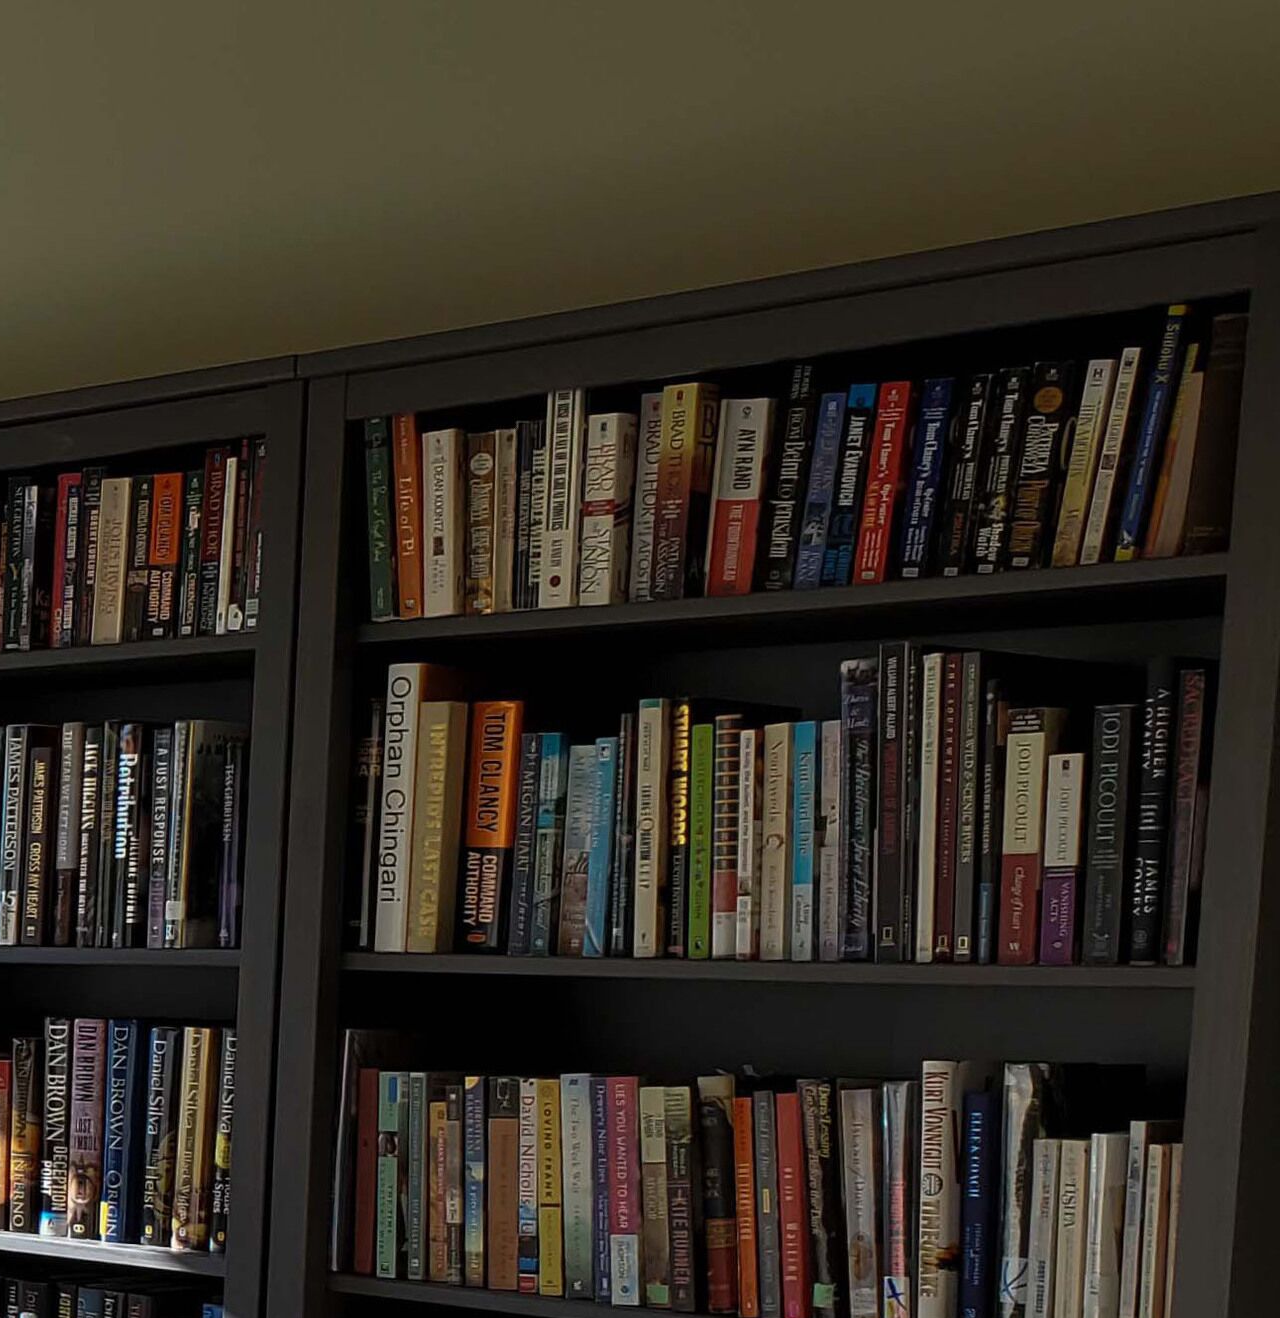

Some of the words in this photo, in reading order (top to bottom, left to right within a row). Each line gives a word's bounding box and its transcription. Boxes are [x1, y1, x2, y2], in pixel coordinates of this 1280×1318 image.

[1160, 323, 1180, 370] Sudoku
[1156, 374, 1168, 383] X
[670, 410, 685, 450] BRAD
[738, 429, 756, 452] AYN
[846, 416, 867, 447] JANET
[1021, 416, 1044, 476] CORNWELL
[208, 471, 221, 508] BRAD
[399, 477, 412, 511] Life
[433, 465, 444, 491] DEAN
[733, 458, 749, 490] RAND
[838, 450, 863, 506] EVANOVICH
[400, 515, 412, 530] of
[433, 494, 444, 532] KOONTZ
[206, 515, 220, 555] THOR
[402, 538, 414, 556] Pi
[598, 529, 611, 573] STATE
[976, 528, 991, 557] Watch
[987, 523, 1003, 561] Shadow
[581, 536, 596, 593] UNION
[147, 570, 161, 623] AUTHORITY
[160, 571, 172, 620] COMMAND
[385, 677, 411, 778] Orphan
[483, 713, 506, 752] TOM
[671, 704, 688, 771] STUART
[1101, 712, 1120, 755] JODI
[1153, 706, 1169, 778] HIGHER
[8, 737, 22, 782] JAMES
[157, 748, 167, 756] A
[964, 739, 975, 767] WILD
[1016, 744, 1031, 776] JODI
[156, 760, 168, 791] JUST
[425, 722, 448, 829] INTREPID'S
[476, 760, 502, 833] CLANCY
[768, 741, 783, 822] Nearlyweds
[520, 770, 538, 826] MEGAN
[670, 776, 687, 845] WOODS
[961, 783, 972, 822] SCENIC
[1014, 781, 1029, 843] PICOULT
[1096, 762, 1118, 842] PICOULT
[4, 786, 20, 870] PATTERSON
[153, 797, 166, 864] RESPONSE
[379, 790, 406, 903] Chingari
[961, 826, 971, 863] RIVERS
[29, 842, 42, 871] CROSS
[422, 837, 443, 883] LAST
[517, 833, 534, 873] HART
[28, 873, 40, 888] MY
[463, 851, 480, 927] AUTHORITY
[478, 855, 497, 923] COMMAND
[26, 890, 39, 919] HEART
[418, 889, 438, 937] CASE
[1059, 882, 1069, 937] VANISHING
[47, 1024, 68, 1067] DAN
[78, 1026, 97, 1050] DAN
[113, 1026, 128, 1070] DAN
[76, 1056, 95, 1102] BROWN
[150, 1039, 167, 1091] Daniel
[46, 1074, 67, 1141] BROWN
[615, 1084, 626, 1106] LIES
[819, 1086, 831, 1117] Doris
[923, 1071, 949, 1103] KURT
[108, 1078, 125, 1150] BROWN
[147, 1095, 164, 1135] Silva
[521, 1096, 534, 1136] David
[543, 1102, 552, 1150] LOVING
[616, 1109, 626, 1132] YOU
[617, 1137, 627, 1179] WANTED
[821, 1120, 830, 1157] Lessing
[923, 1108, 947, 1169] VONNEGUT
[52, 1146, 68, 1211] DECEPTION
[521, 1144, 534, 1204] Nicholls
[545, 1157, 553, 1197] FRANK
[617, 1183, 627, 1197] TO
[618, 1202, 628, 1228] HEAR
[671, 1197, 687, 1227] KITE
[673, 1231, 689, 1284] RUNNER
[9, 1286, 17, 1303] THE
